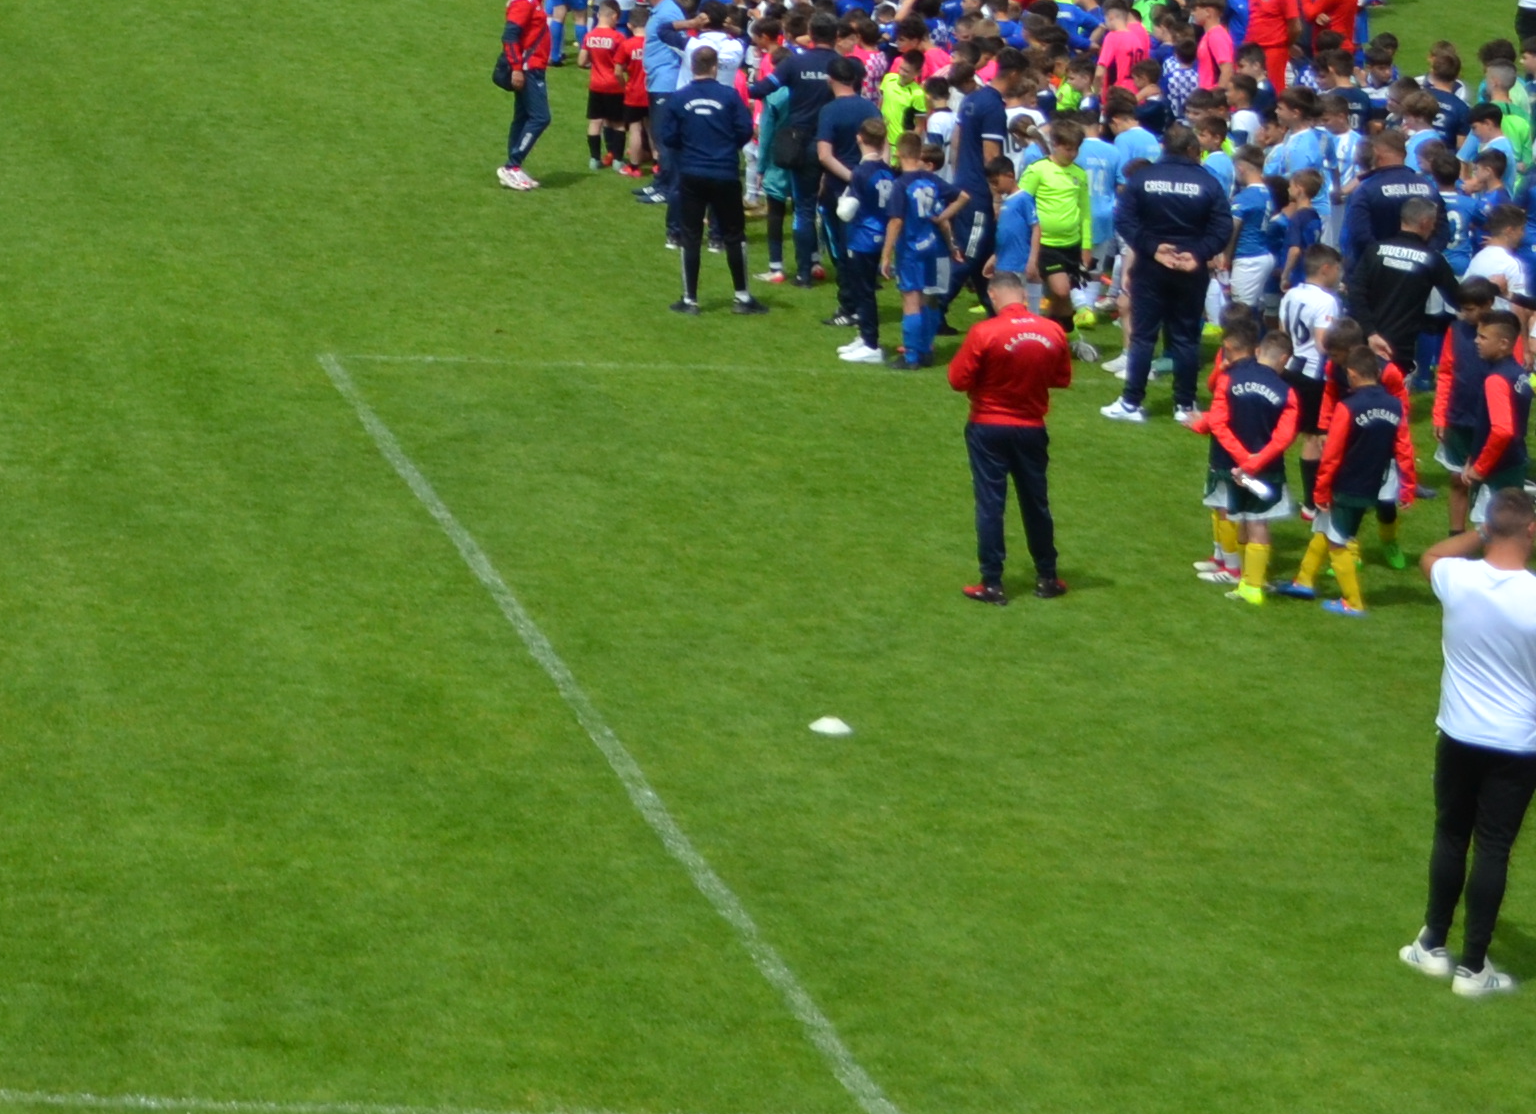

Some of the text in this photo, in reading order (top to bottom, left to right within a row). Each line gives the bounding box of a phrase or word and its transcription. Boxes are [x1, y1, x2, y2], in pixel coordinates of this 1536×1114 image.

[1377, 244, 1428, 264] JUVENTUS
[1285, 299, 1310, 347] 16
[1231, 384, 1243, 397] CS
[1354, 413, 1366, 427] CS
